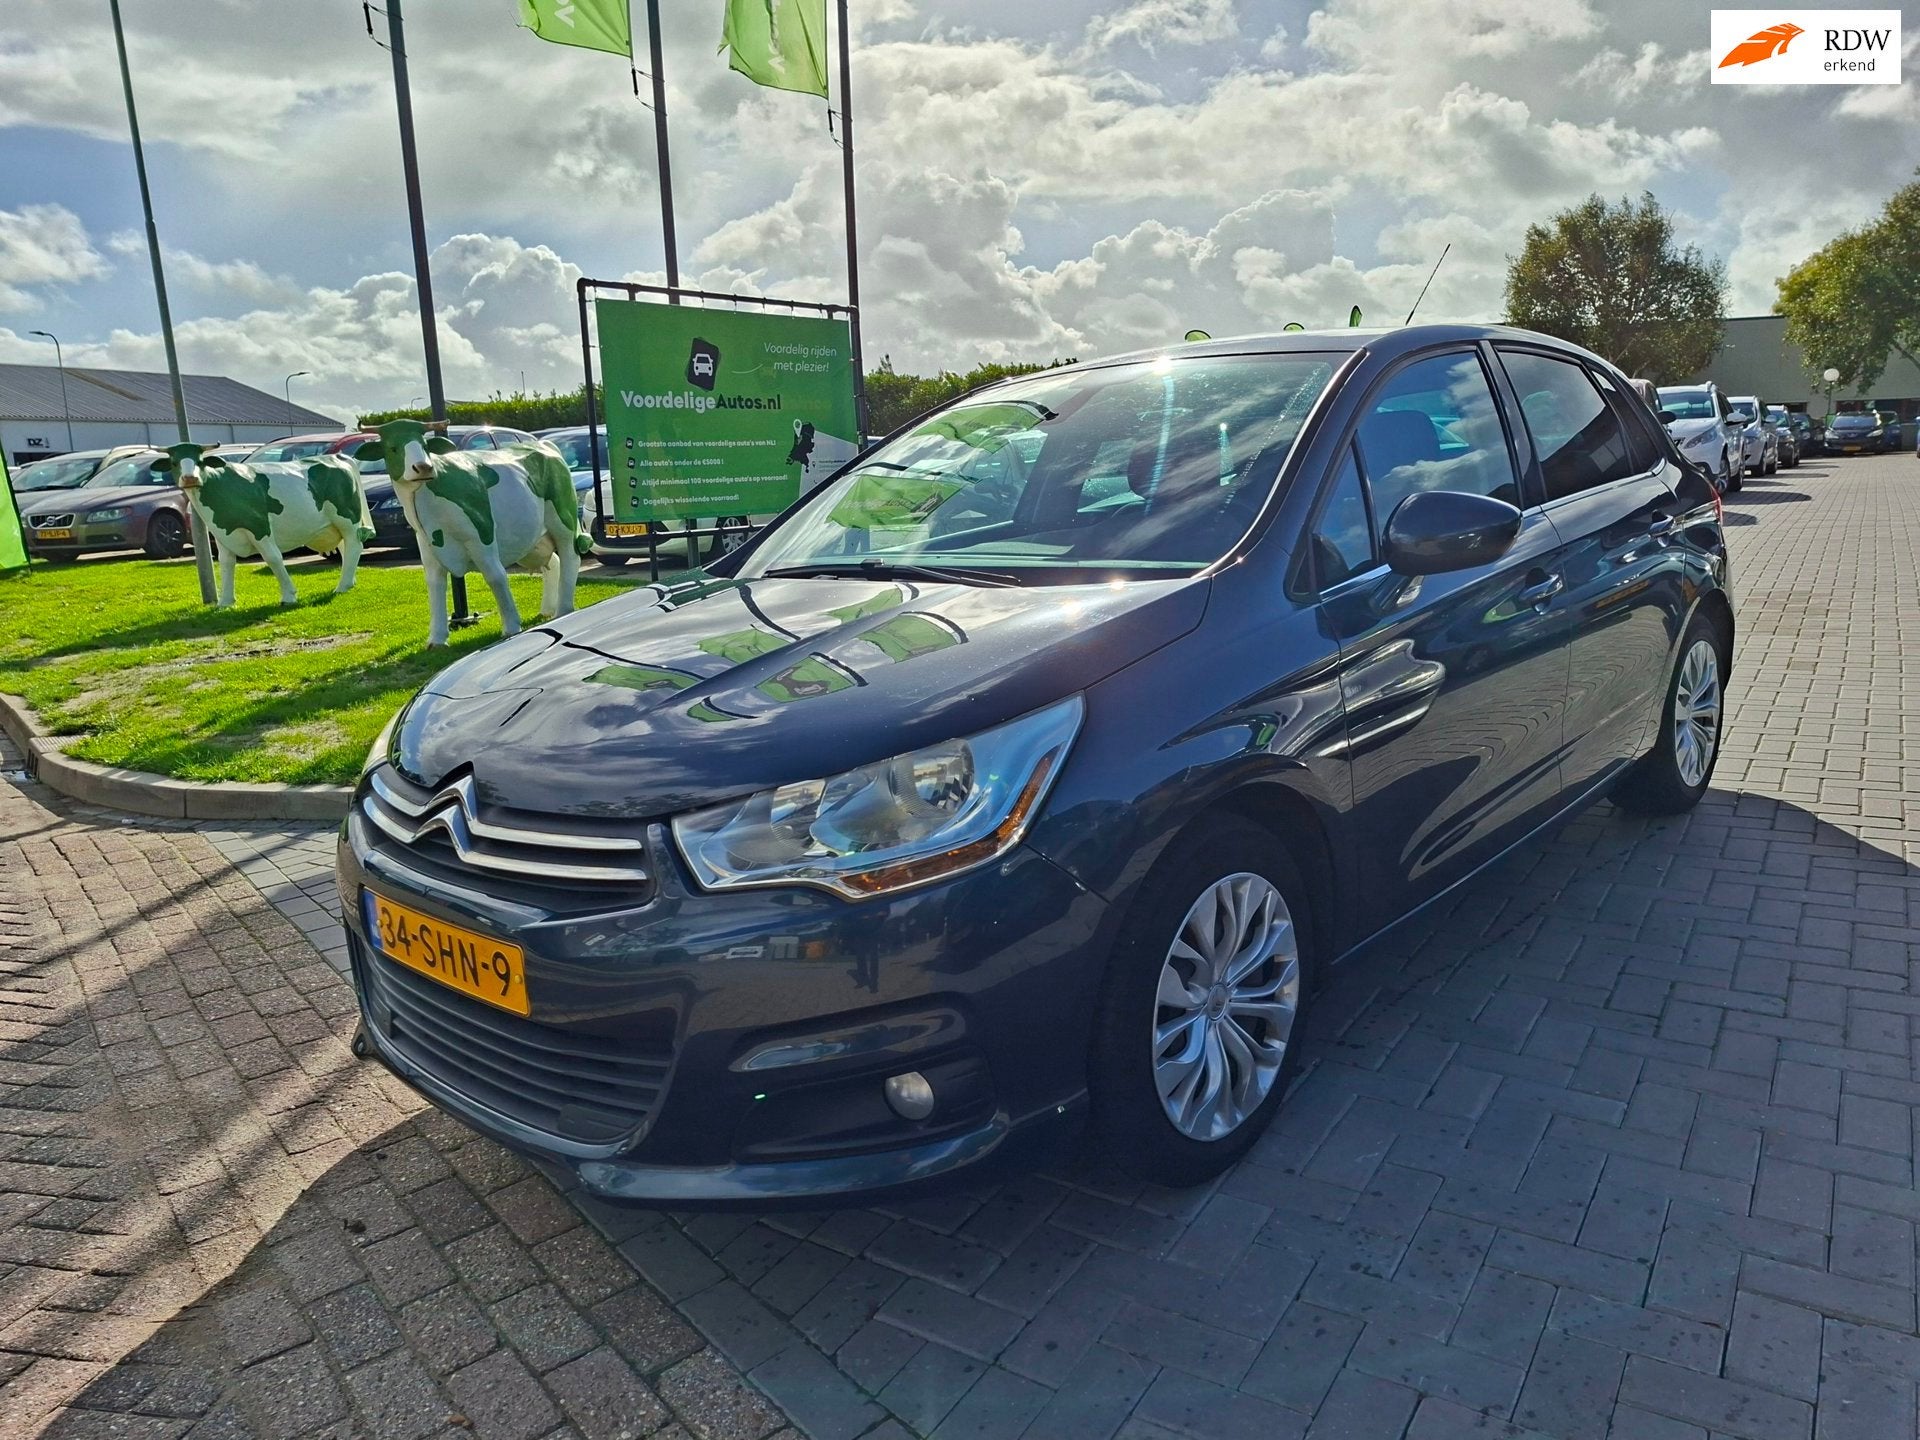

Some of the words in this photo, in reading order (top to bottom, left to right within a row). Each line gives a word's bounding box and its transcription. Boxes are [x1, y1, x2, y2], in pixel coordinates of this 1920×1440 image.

[763, 342, 809, 358] Voordelig
[810, 345, 837, 359] rijden
[773, 361, 793, 371] met
[794, 360, 829, 373] plezier!
[620, 390, 782, 414] VoordeligeAutos.nl
[653, 459, 674, 467] auto's
[641, 478, 660, 487] Altijd
[660, 477, 690, 485] minimaal
[734, 475, 753, 483] auto's
[381, 907, 511, 996] 34-SHN-9
